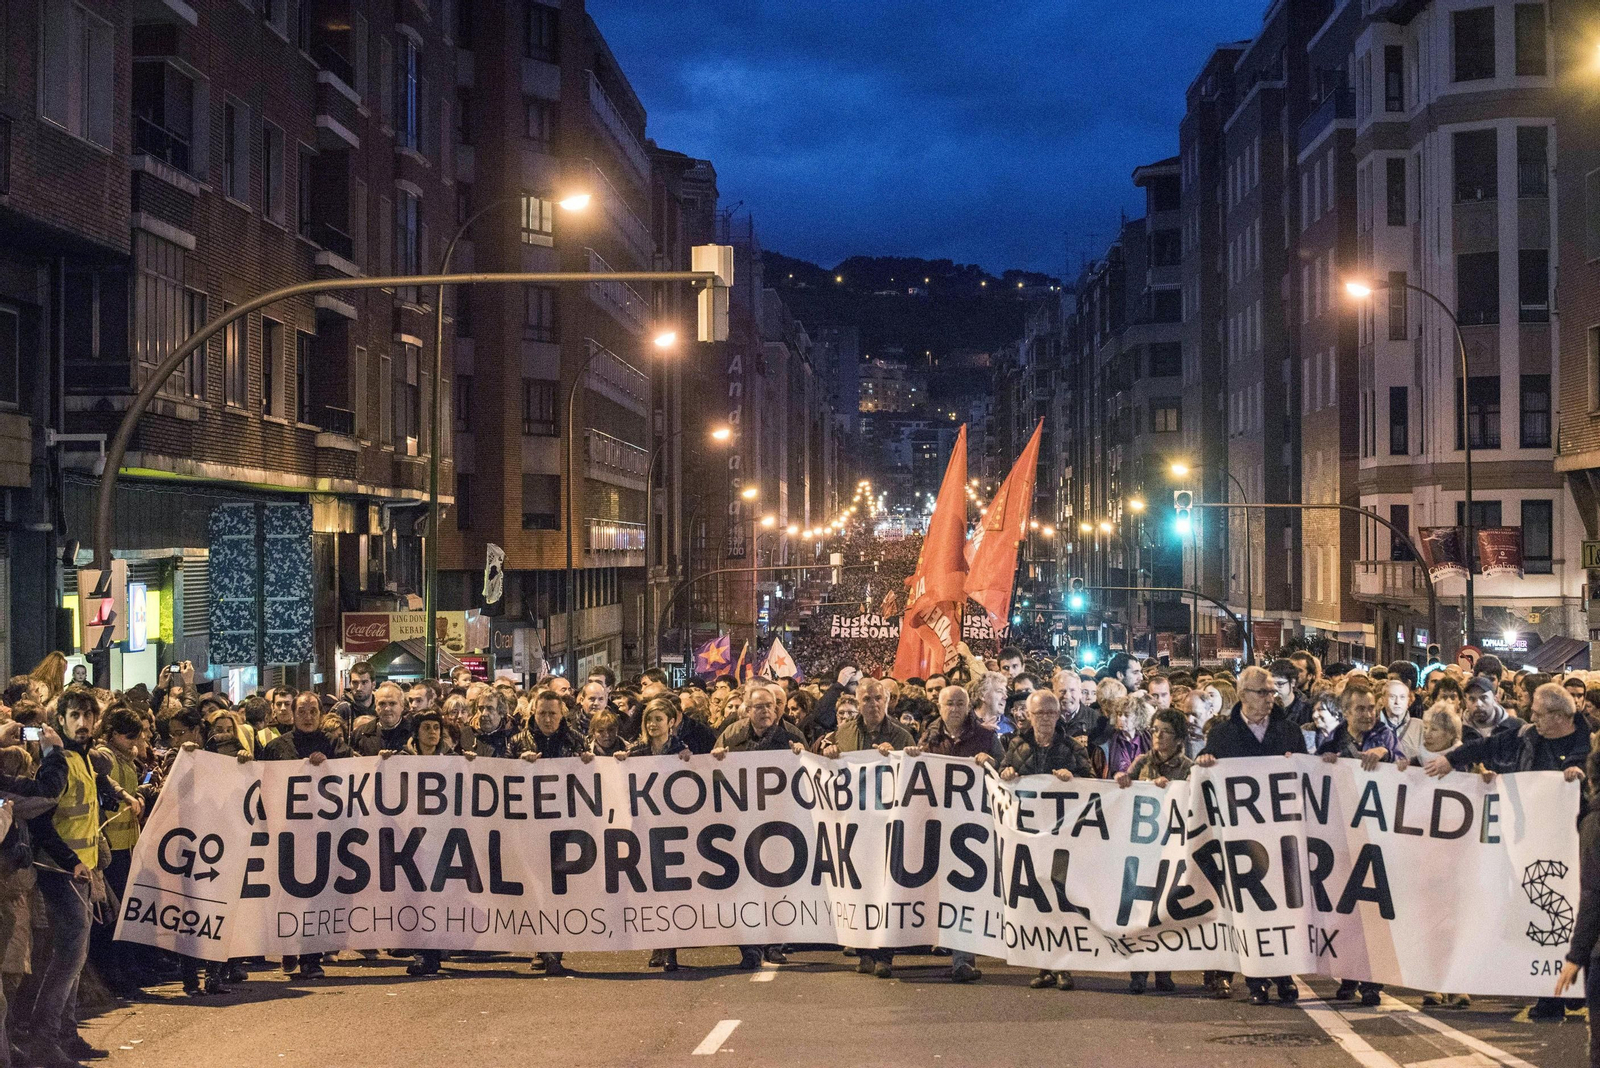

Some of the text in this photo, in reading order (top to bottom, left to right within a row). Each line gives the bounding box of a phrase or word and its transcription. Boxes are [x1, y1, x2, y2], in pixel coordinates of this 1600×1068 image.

[728, 546, 744, 556] 700
[392, 614, 427, 623] KING DONE
[832, 614, 889, 628] EUSKAL
[400, 626, 424, 634] KEBAB
[830, 626, 898, 639] PRESOAK
[285, 771, 615, 824] ESKUBIDEEN,
[1016, 790, 1111, 841] ETA
[1350, 780, 1501, 844] ALDE
[240, 826, 524, 899] EUSKAL
[549, 820, 862, 895] PRESOAK
[277, 905, 437, 938] DERECHOS
[446, 906, 614, 939] HUMANOS,
[623, 895, 818, 934] RESOLUCIÓN
[836, 901, 858, 930] PAZ
[938, 902, 975, 934] DE
[1258, 925, 1296, 958] ET
[1530, 960, 1563, 976] SAR
